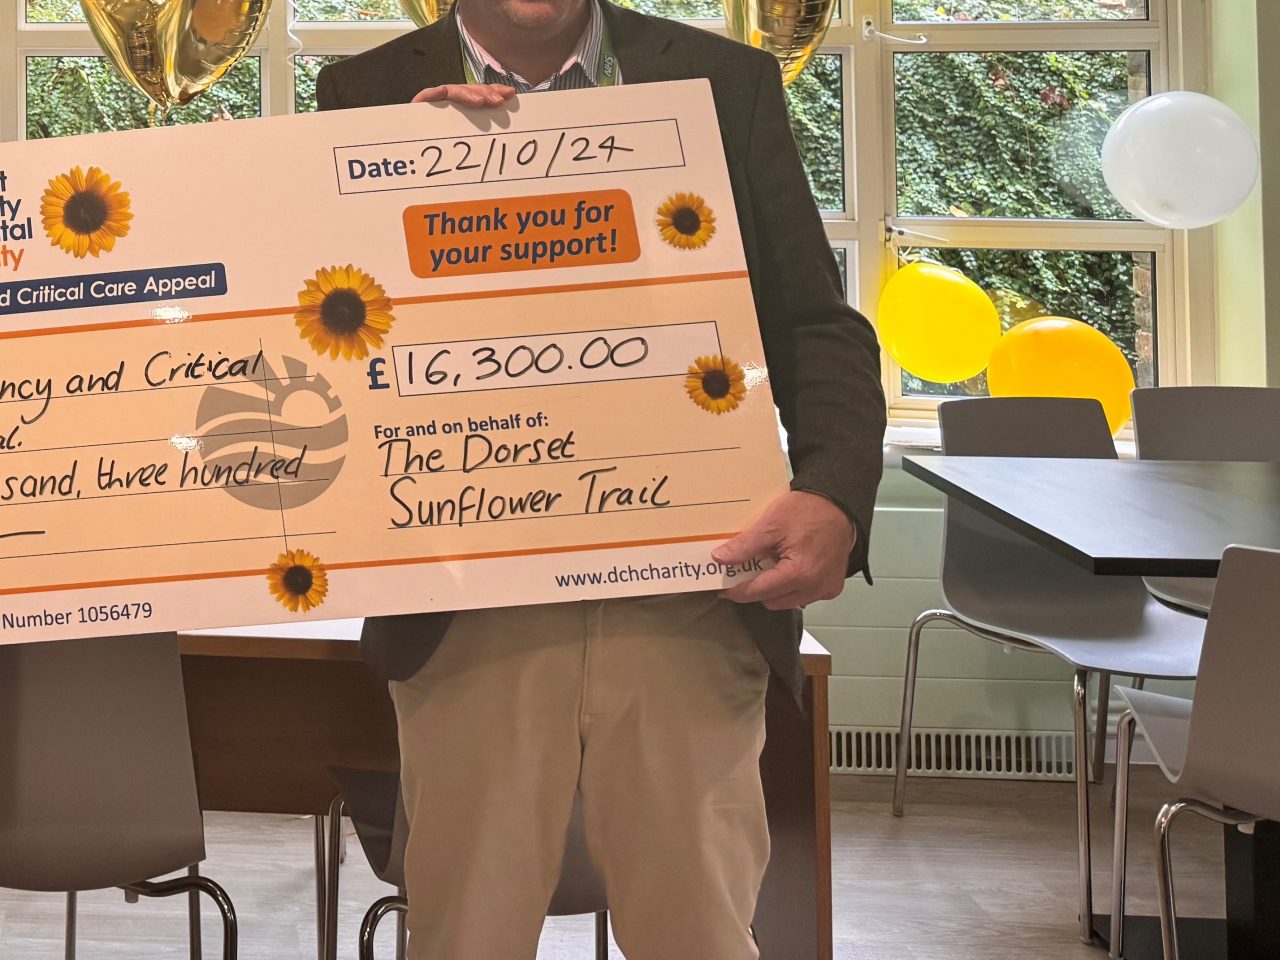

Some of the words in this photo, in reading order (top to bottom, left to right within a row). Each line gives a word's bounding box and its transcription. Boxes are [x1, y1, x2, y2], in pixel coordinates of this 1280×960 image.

[603, 54, 614, 78] NHS
[347, 155, 416, 180] Date:
[420, 131, 634, 182] 22/10/24
[424, 207, 508, 237] Thank
[516, 205, 567, 234] you
[574, 200, 615, 231] for
[430, 244, 494, 272] your
[499, 228, 618, 265] support!
[17, 279, 85, 307] Critical
[90, 276, 137, 300] Care
[143, 270, 216, 298] Appeal
[65, 360, 125, 394] and
[144, 350, 264, 388] Critical
[366, 358, 390, 391] £
[407, 336, 649, 387] 16,300.00
[374, 423, 401, 440] For
[405, 420, 437, 437] and
[442, 420, 464, 434] on
[467, 413, 522, 433] behalf
[525, 411, 549, 429] of:
[96, 455, 169, 491] three
[179, 443, 308, 488] hundred
[378, 438, 445, 477] The
[462, 431, 575, 473] Dorset
[390, 475, 562, 529] Sunflower
[578, 466, 671, 515] Trail
[555, 556, 764, 588] www.dchcharity.org.uk
[2, 608, 72, 629] Number
[78, 601, 153, 624] 1056479
